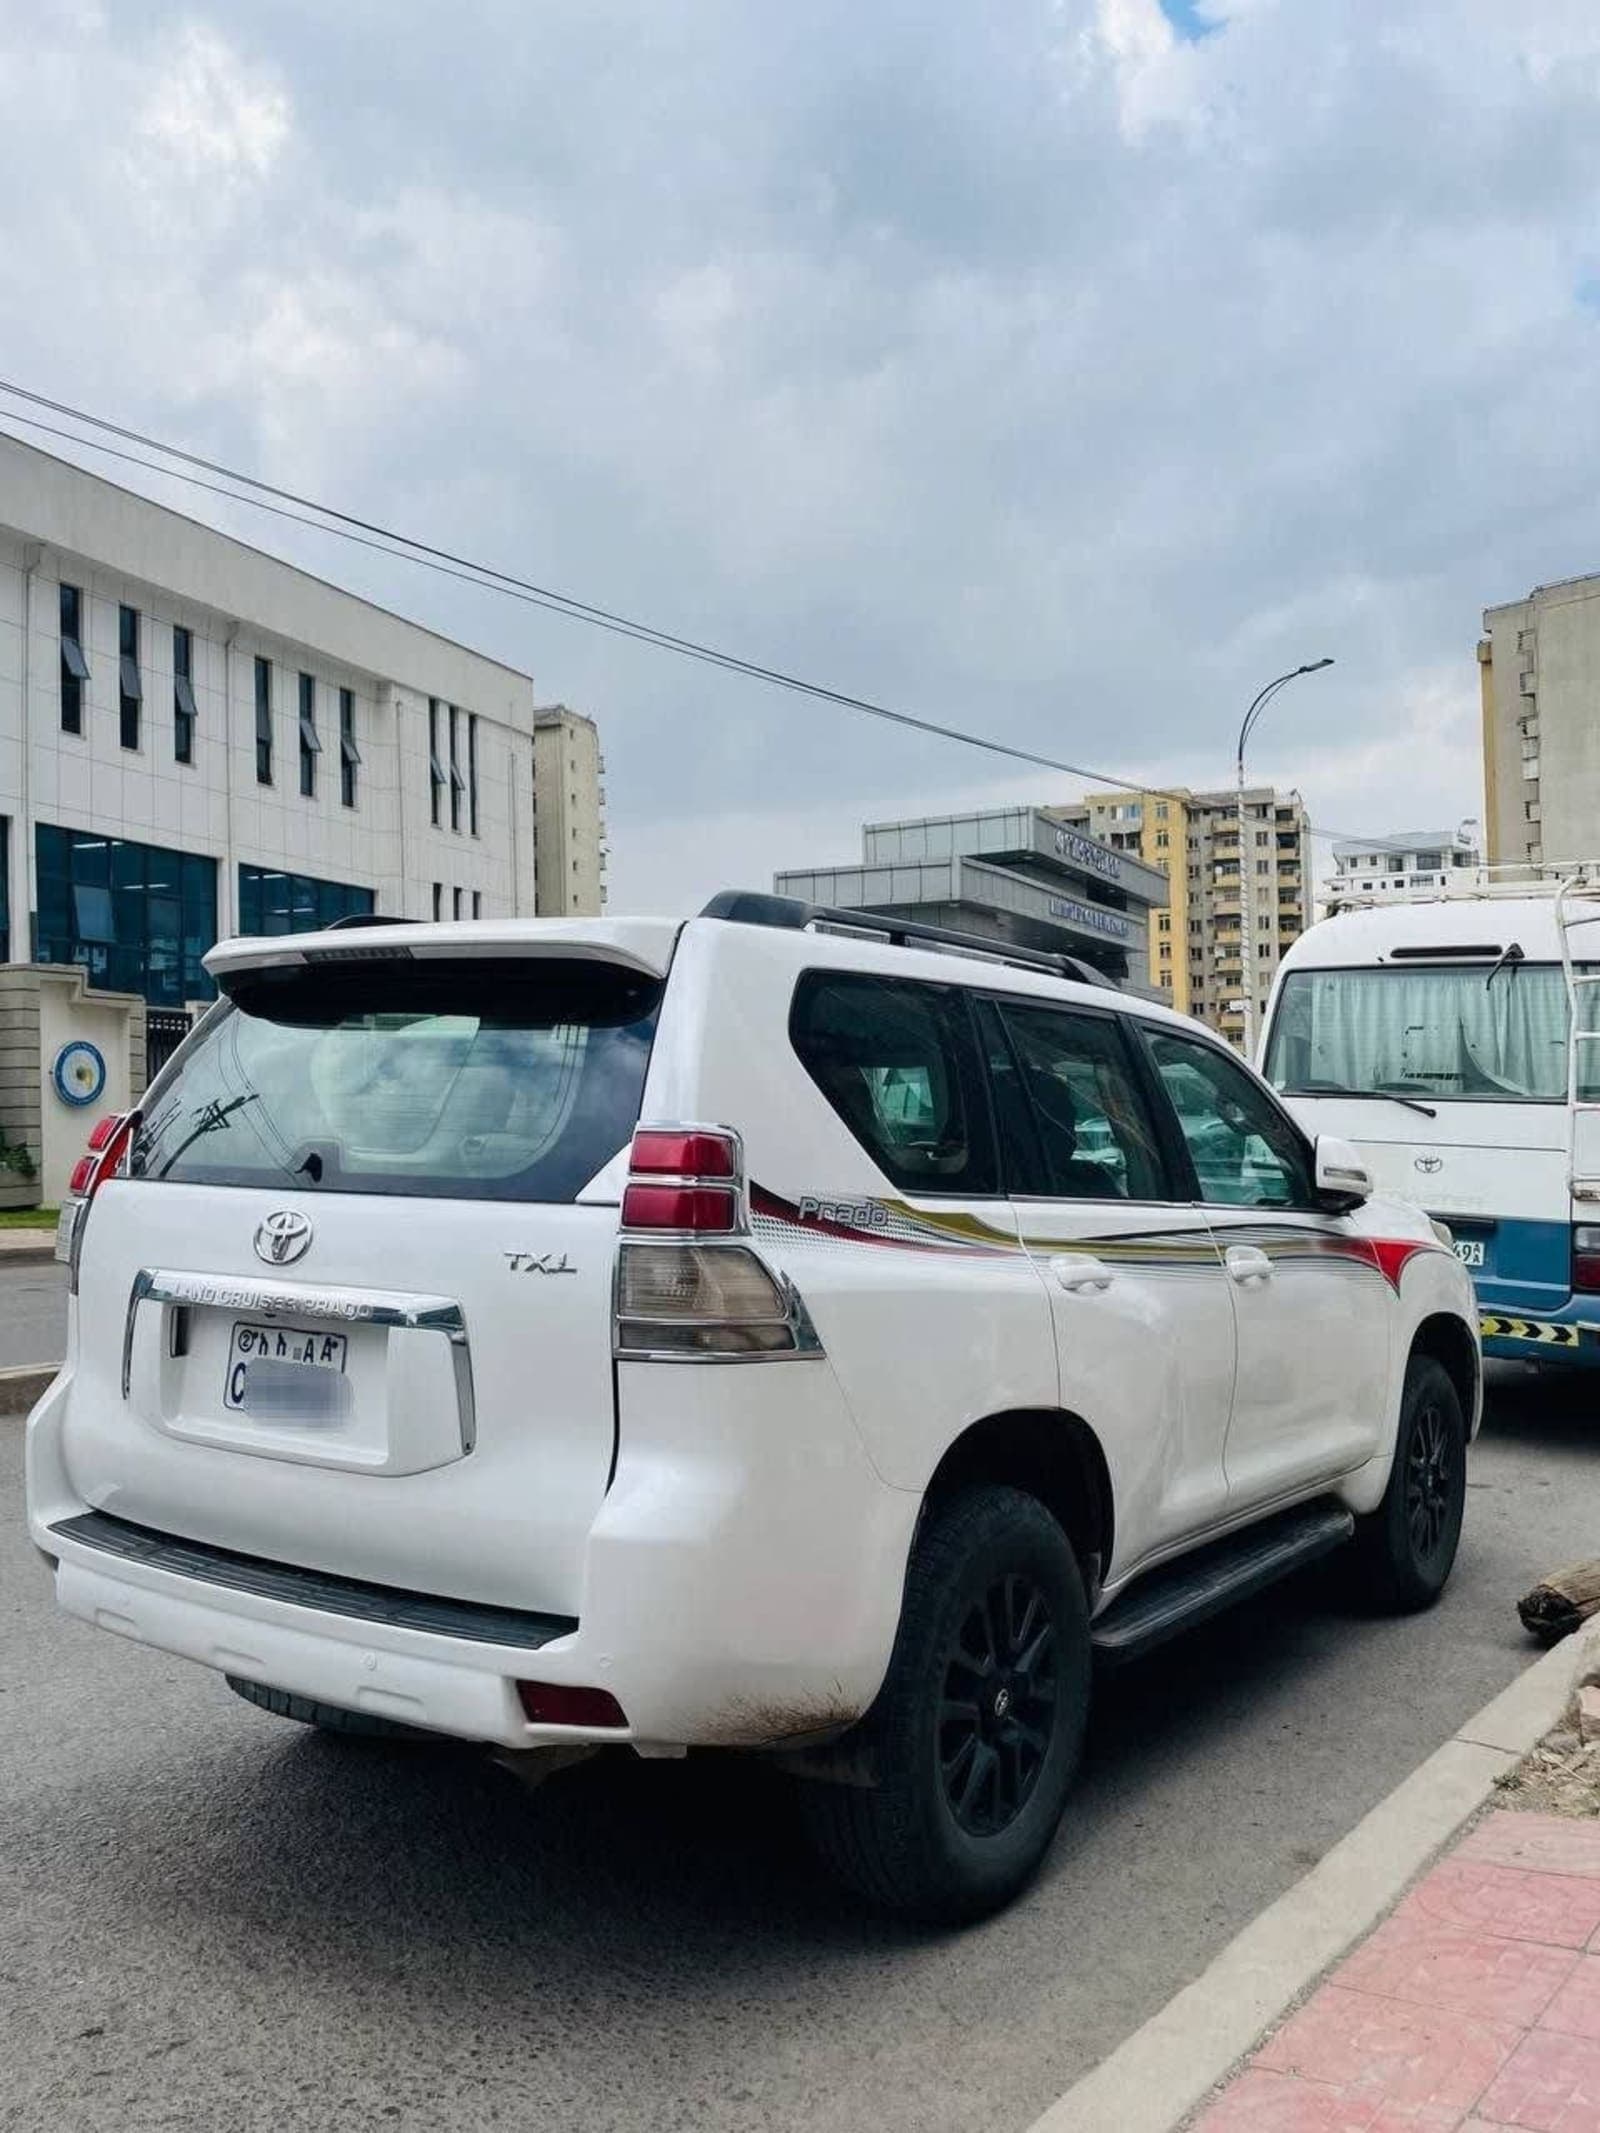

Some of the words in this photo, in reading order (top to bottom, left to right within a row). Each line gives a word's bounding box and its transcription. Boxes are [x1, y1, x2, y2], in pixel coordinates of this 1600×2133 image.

[799, 1196, 888, 1227] Prado
[173, 1280, 216, 1302] LAND
[218, 1287, 297, 1311] CRUISER
[303, 1292, 373, 1320] PRADO
